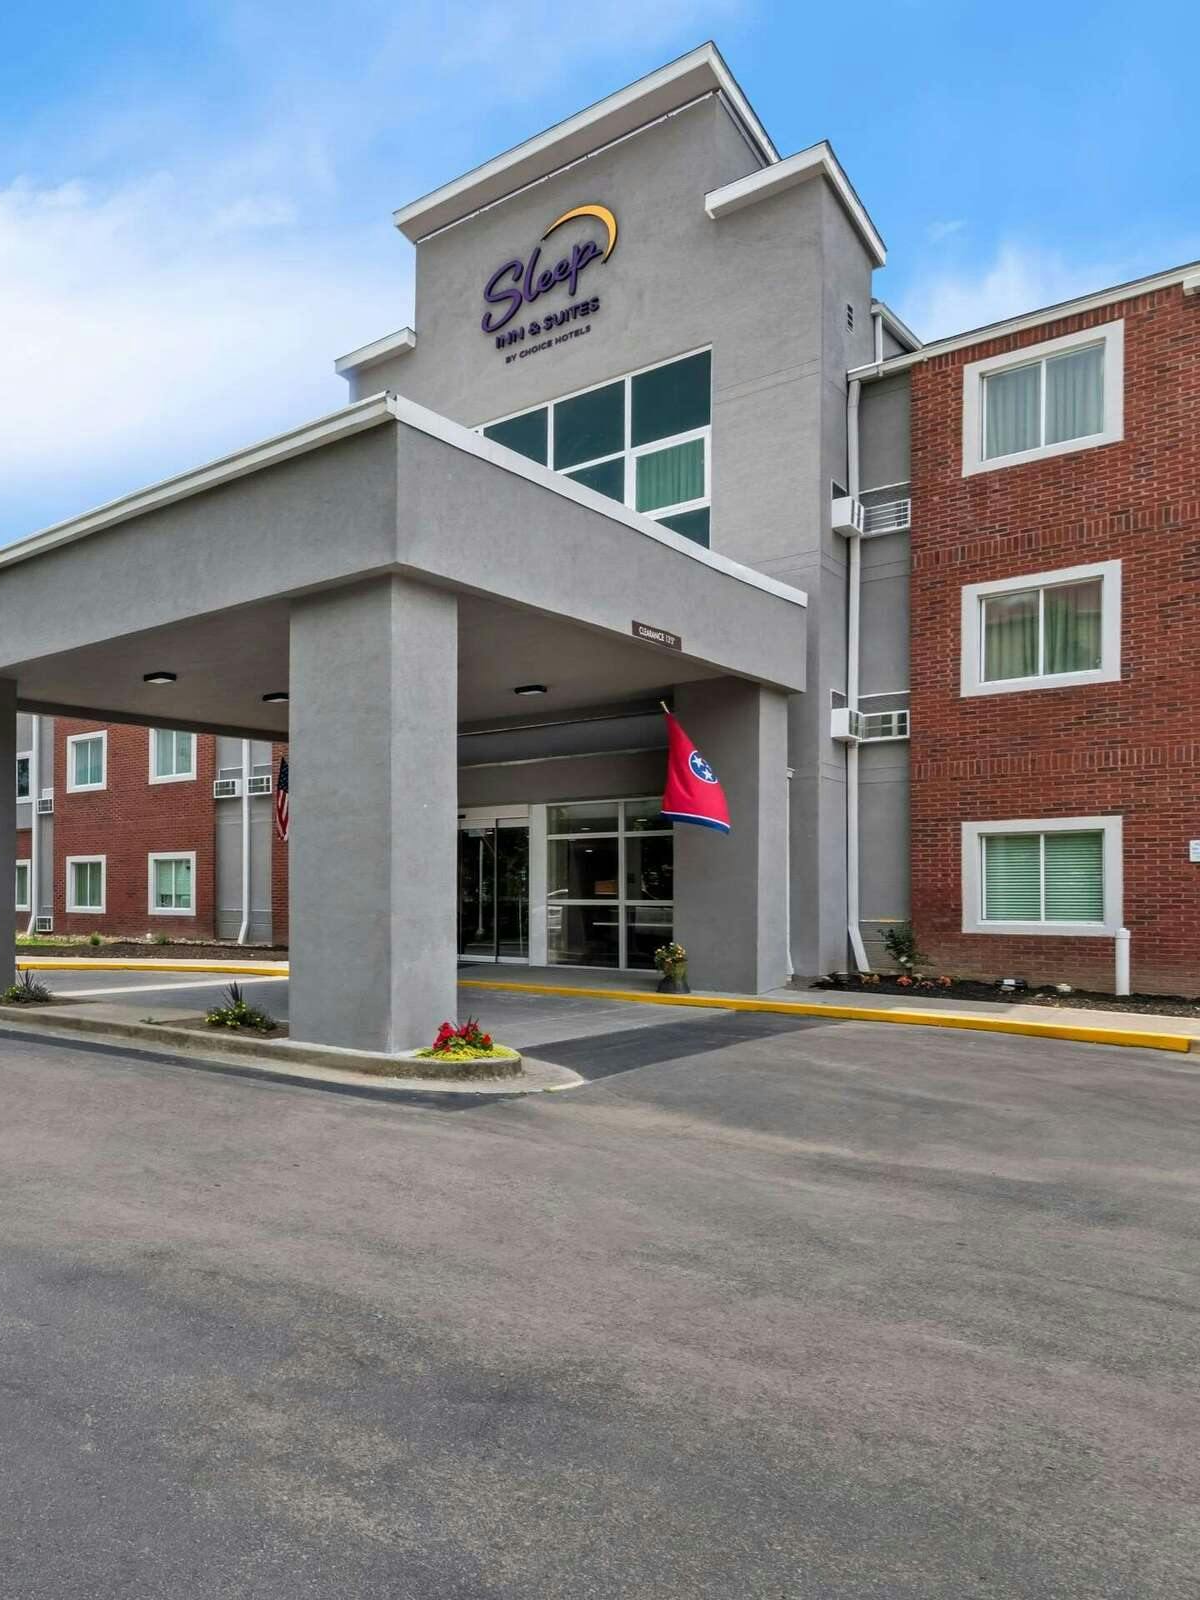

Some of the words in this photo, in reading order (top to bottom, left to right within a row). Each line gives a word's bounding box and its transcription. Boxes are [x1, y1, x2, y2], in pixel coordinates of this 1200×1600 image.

[482, 241, 603, 333] Sleep
[495, 325, 525, 350] INN
[528, 320, 541, 336] &
[543, 297, 600, 330] SUITES
[505, 353, 518, 365] BY
[519, 339, 553, 359] CHOICE
[554, 324, 592, 346] HOTELS
